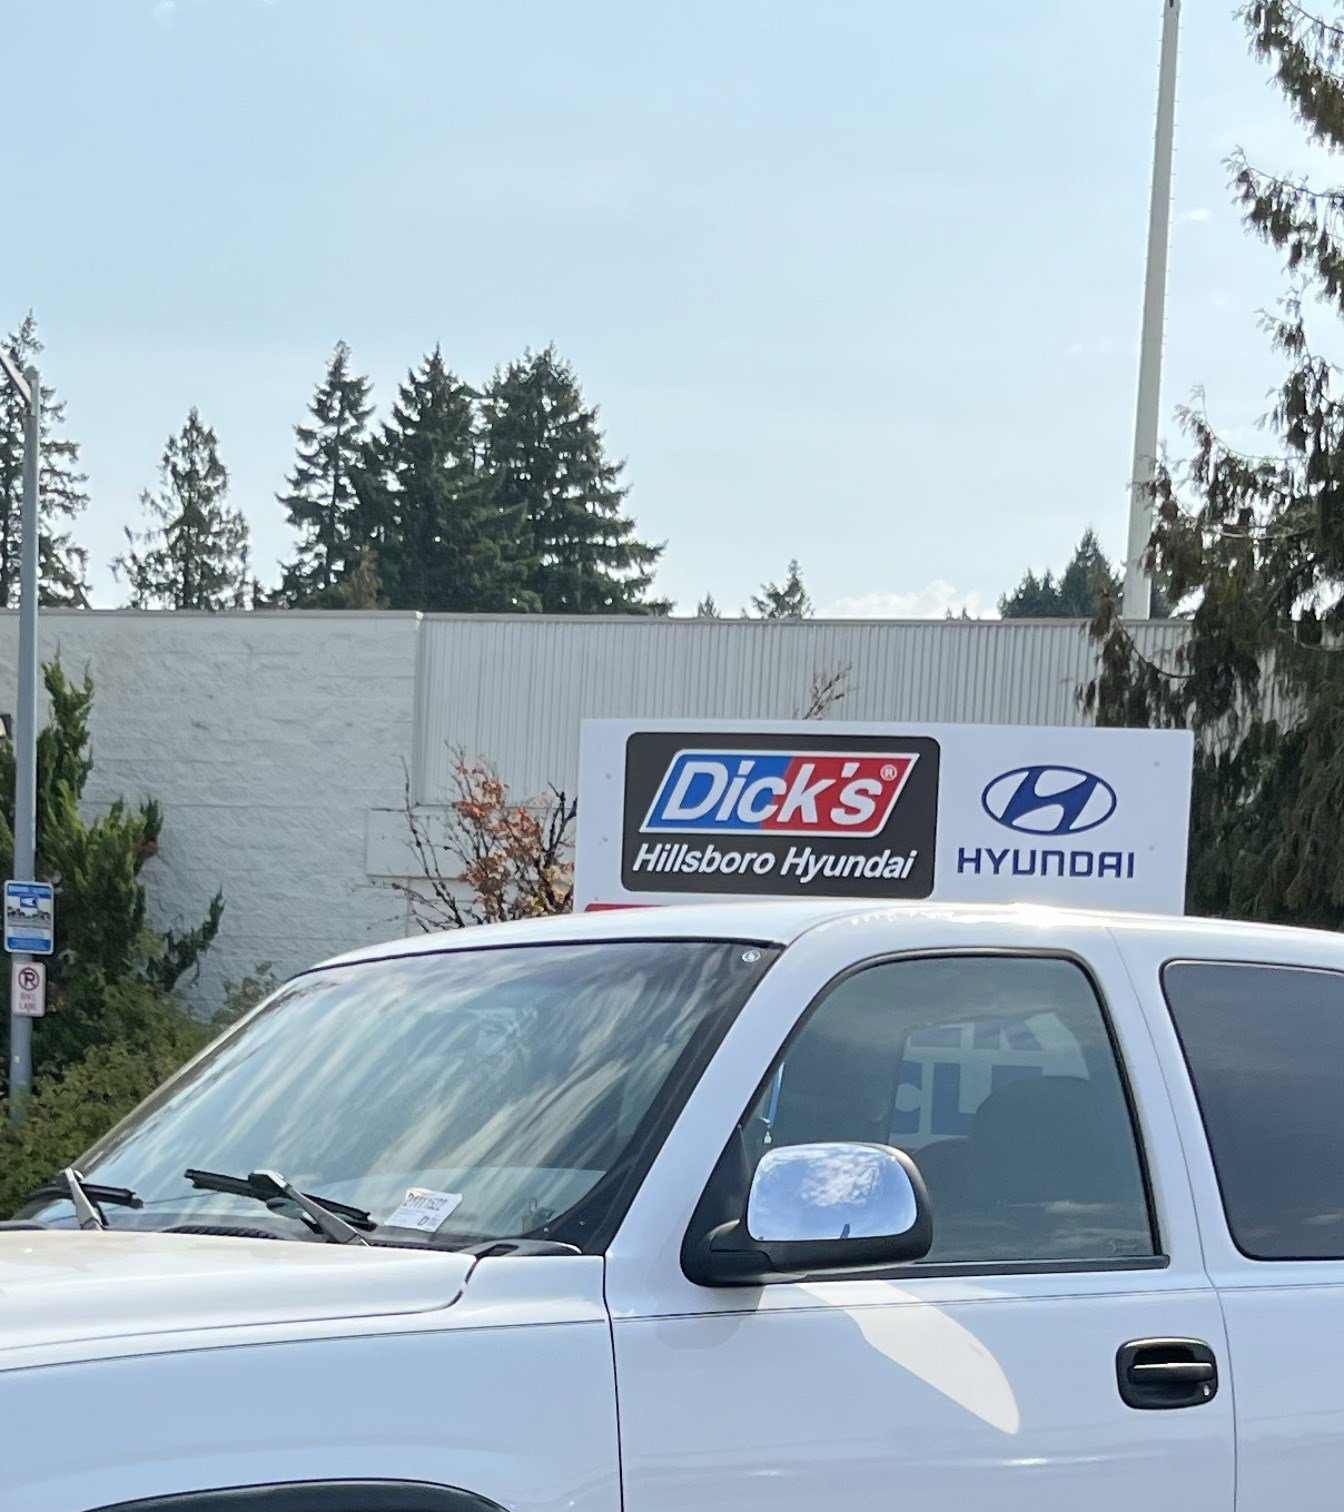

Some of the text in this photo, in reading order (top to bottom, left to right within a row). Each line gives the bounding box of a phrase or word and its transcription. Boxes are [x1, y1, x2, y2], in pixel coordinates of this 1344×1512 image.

[661, 760, 882, 825] Dick's
[632, 843, 918, 883] Hillsboro Hyundai
[957, 847, 1134, 878] HYUNDAI
